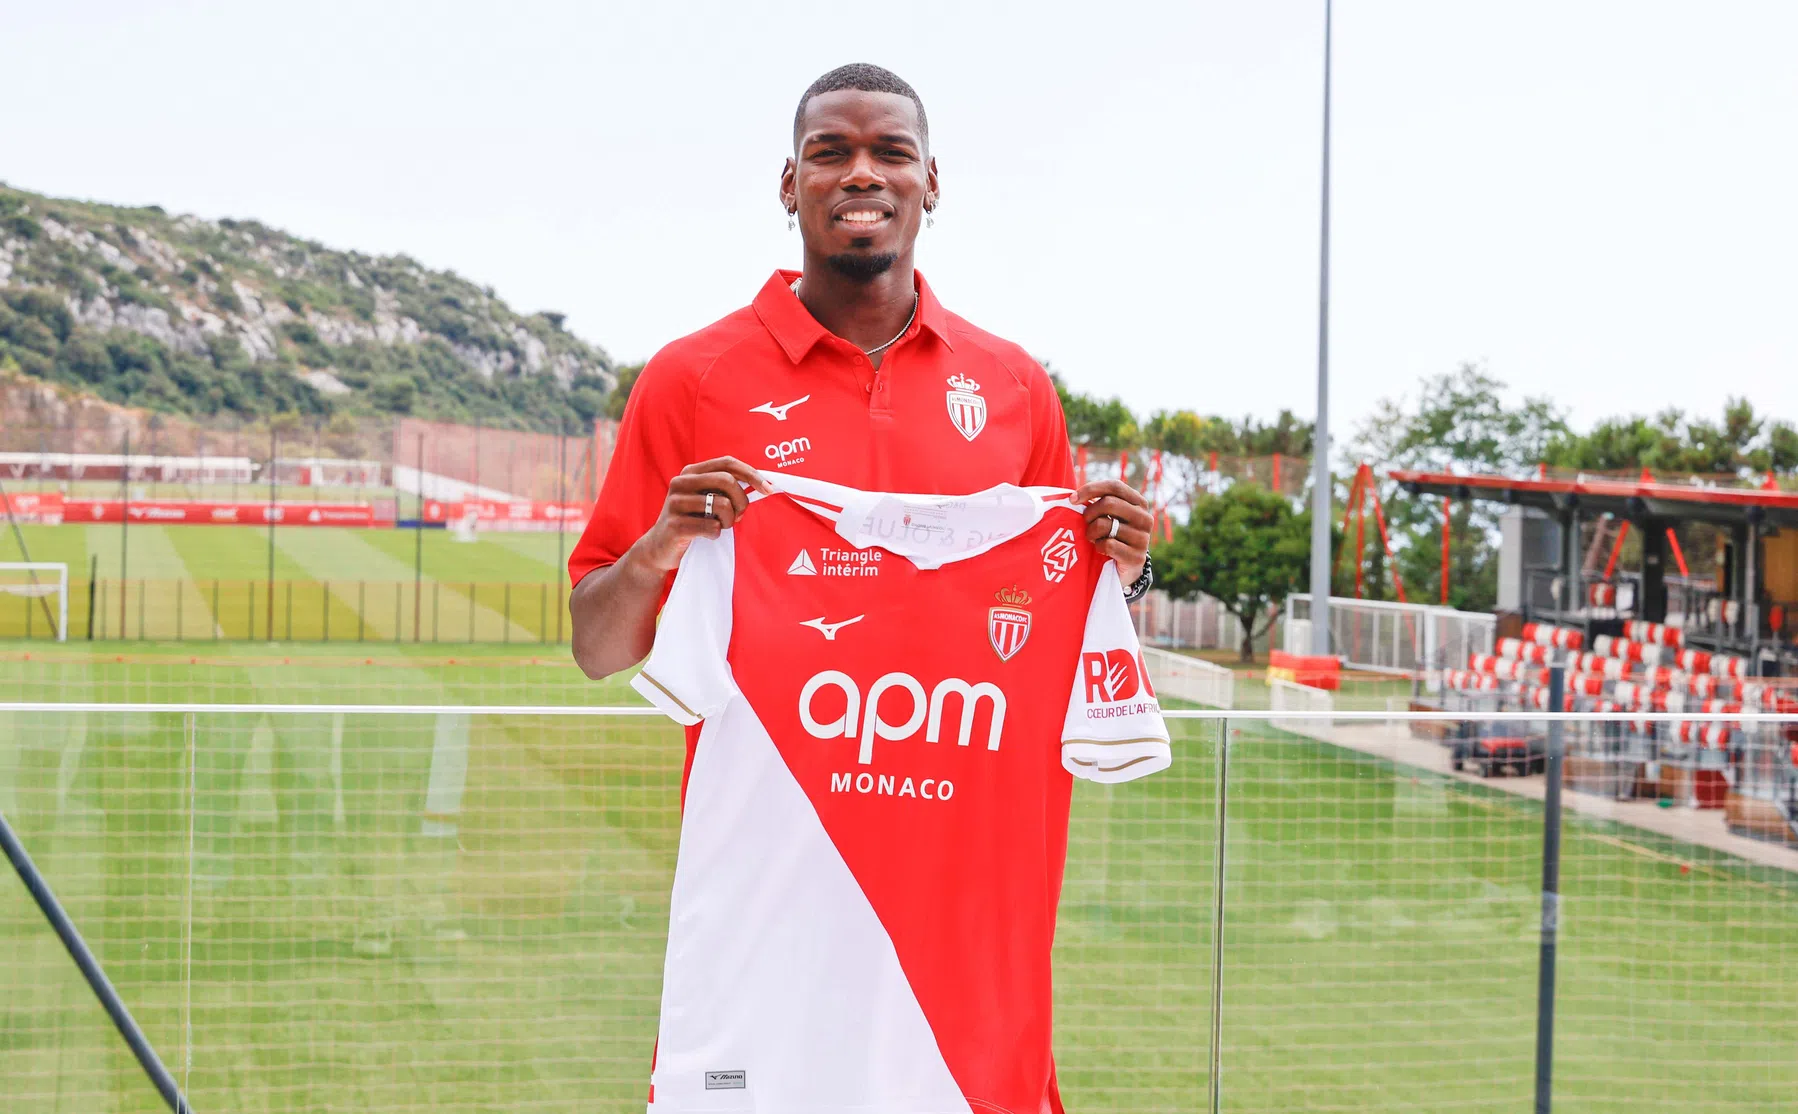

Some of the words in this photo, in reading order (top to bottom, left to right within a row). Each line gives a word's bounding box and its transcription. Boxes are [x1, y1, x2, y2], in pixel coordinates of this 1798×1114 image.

[764, 437, 811, 461] apm
[777, 457, 804, 469] MONACO
[820, 548, 882, 565] Triangle
[823, 563, 878, 577] intérim
[799, 670, 1007, 764] apm
[1116, 705, 1127, 717] DE
[831, 773, 954, 801] MONACO
